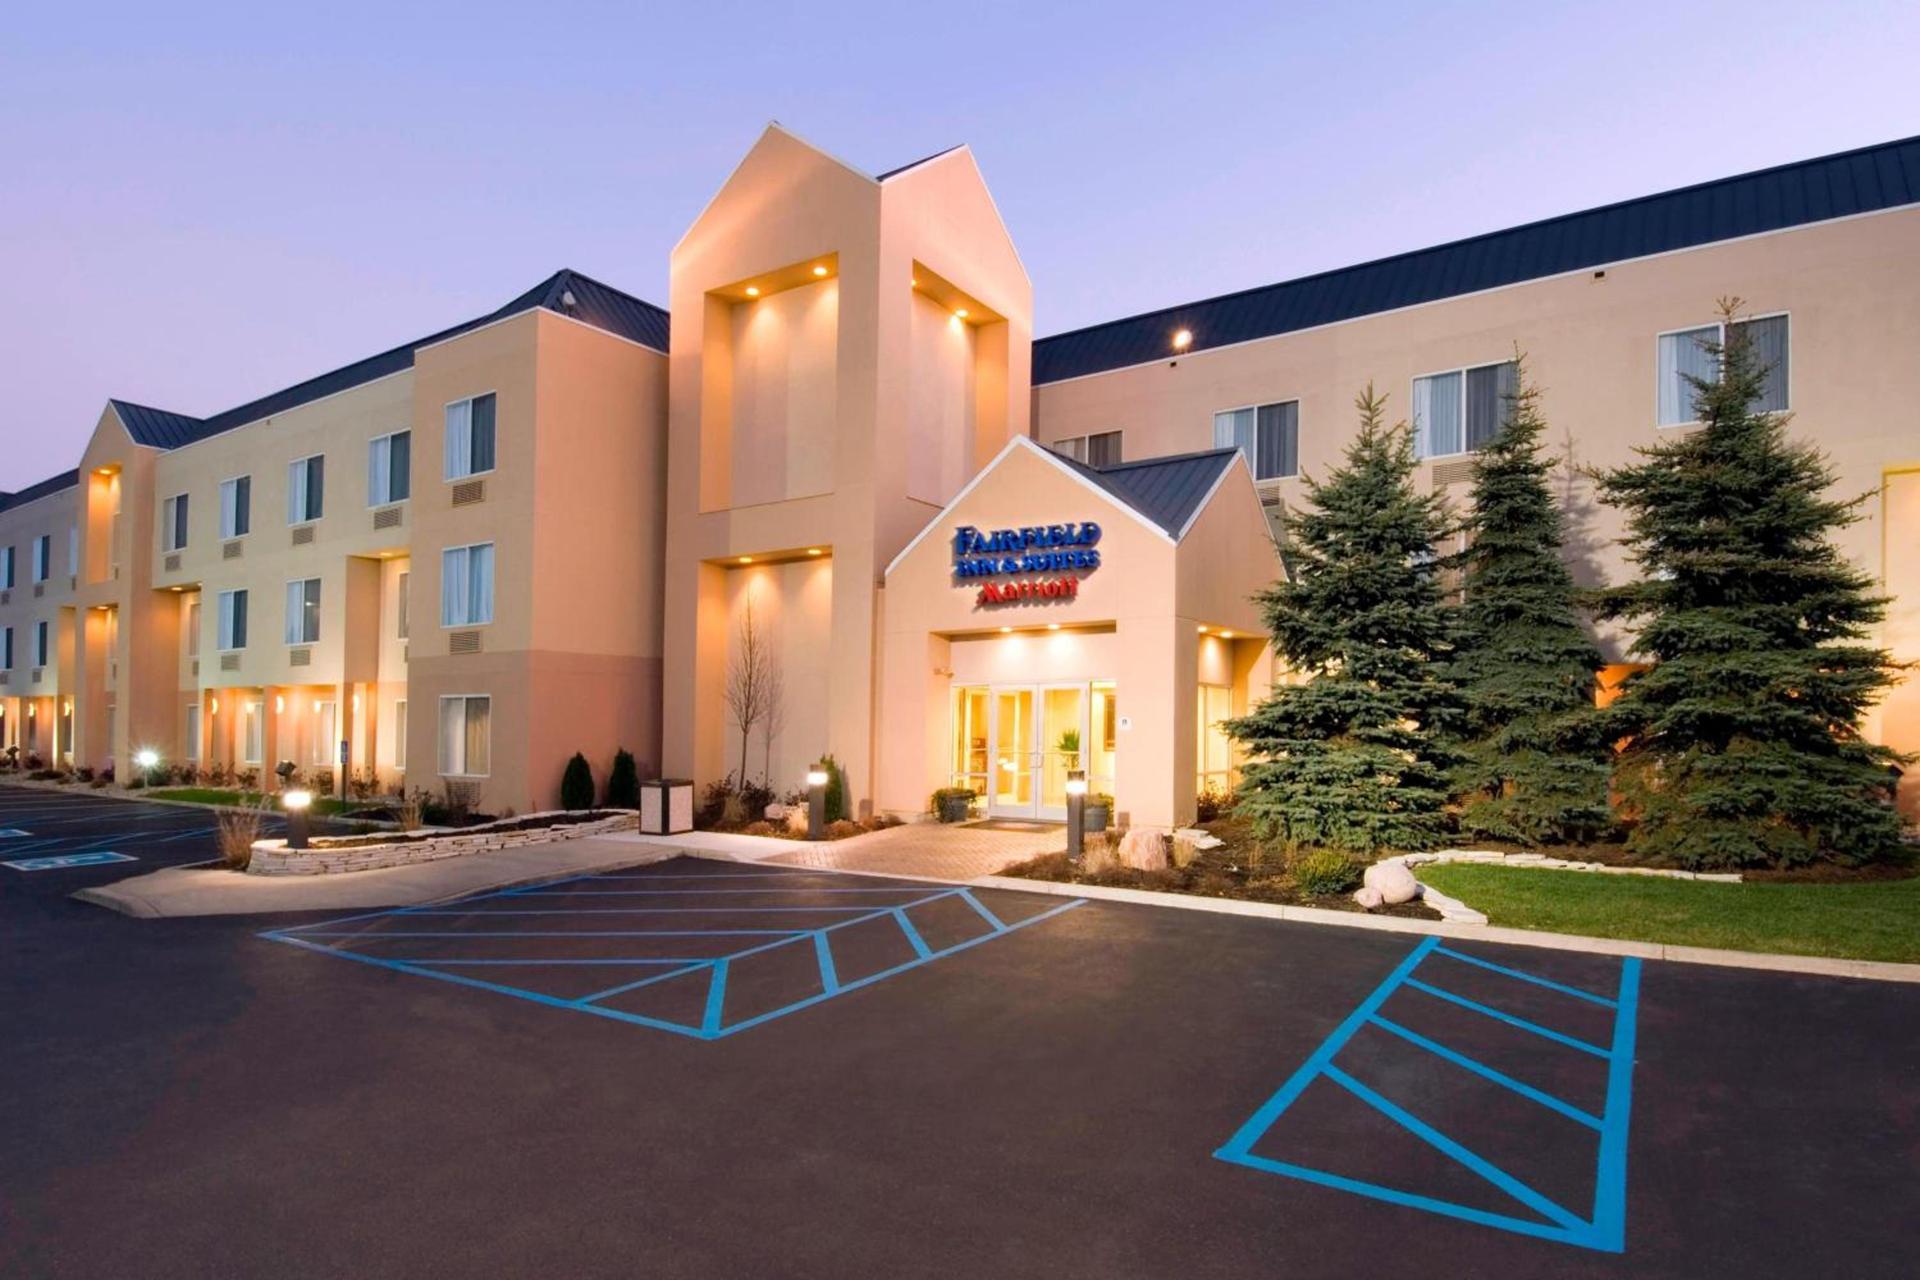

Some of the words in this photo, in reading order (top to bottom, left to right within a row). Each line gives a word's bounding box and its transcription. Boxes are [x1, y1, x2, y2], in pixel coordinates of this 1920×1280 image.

[955, 522, 1102, 555] FAIRFIELD
[956, 557, 998, 576] INN
[1002, 557, 1018, 573] &
[1022, 550, 1101, 571] SUITES
[977, 576, 1078, 604] Marriott
